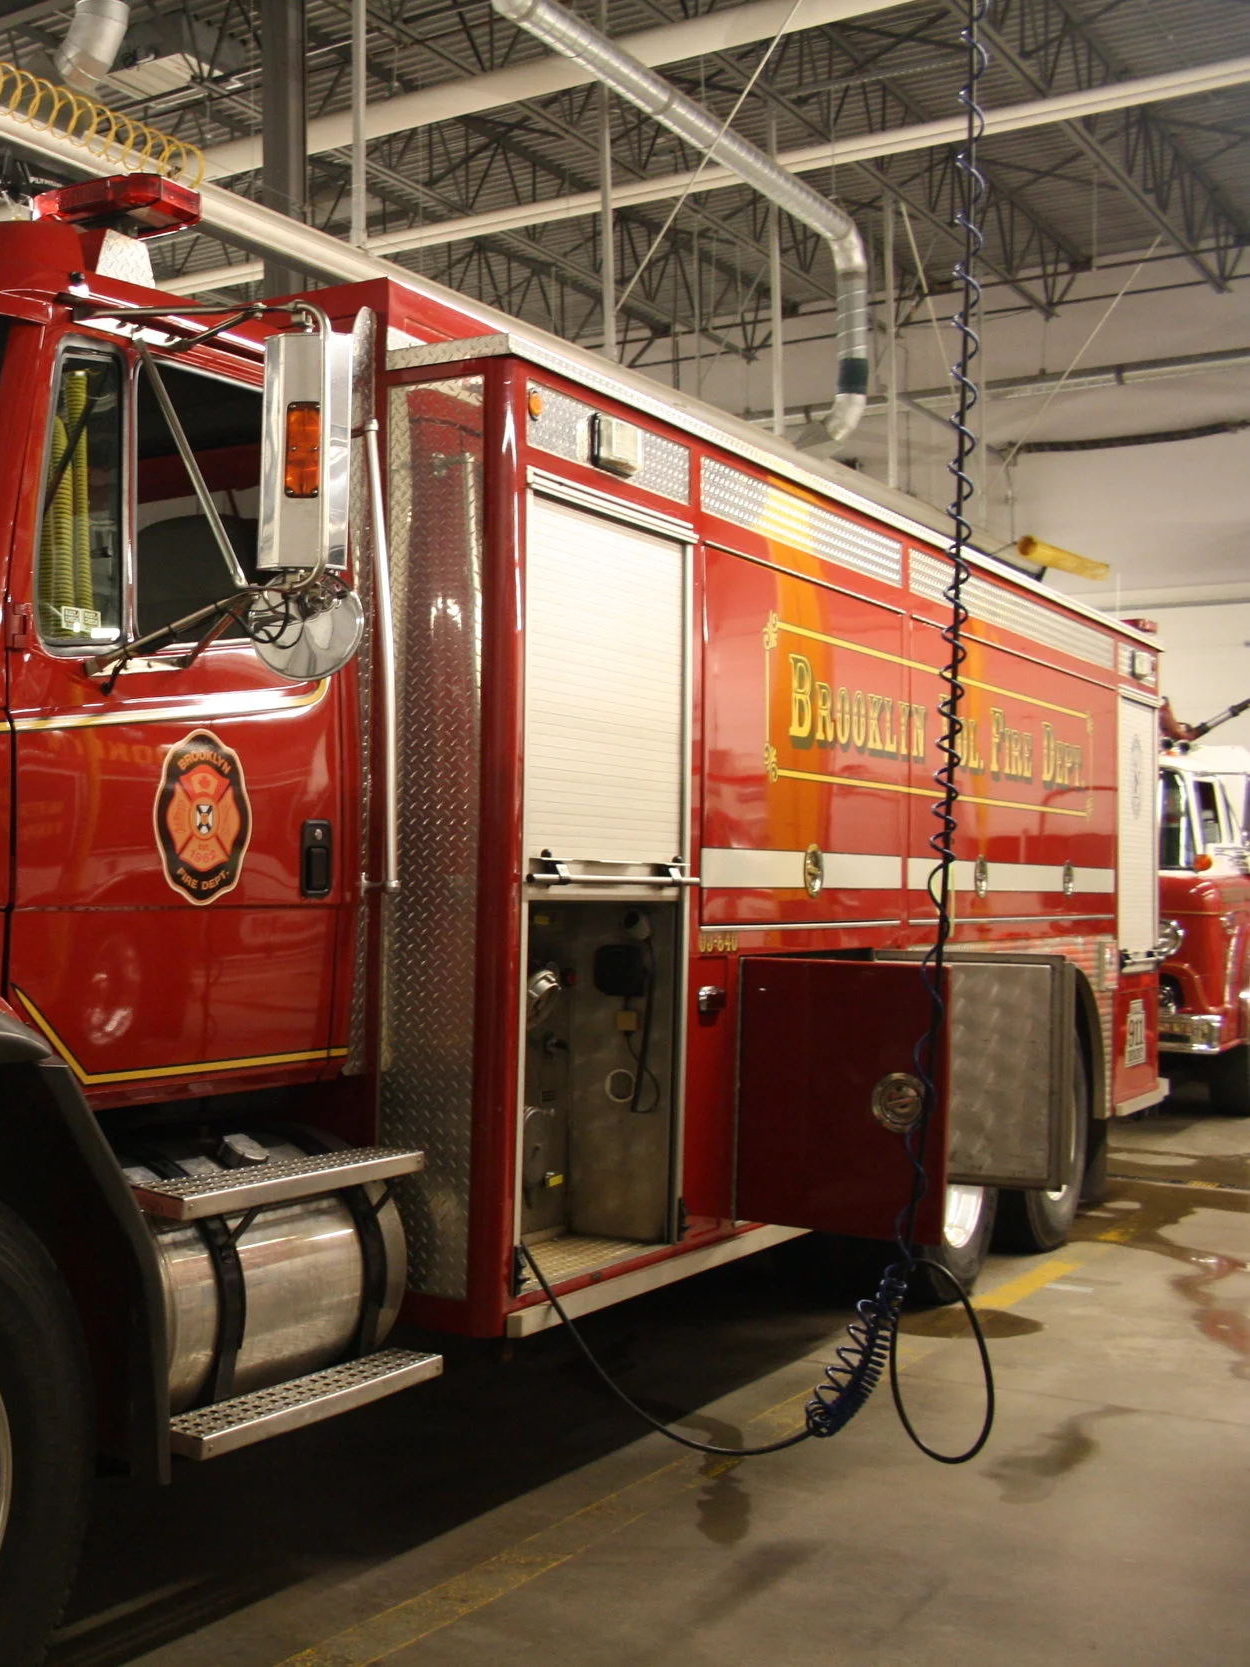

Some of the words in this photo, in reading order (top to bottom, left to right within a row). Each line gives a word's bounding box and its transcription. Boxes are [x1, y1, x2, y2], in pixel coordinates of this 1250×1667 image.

[788, 653, 926, 762] BROOKLYN
[990, 707, 1034, 779] FIRE
[177, 749, 232, 775] BROOKLYN
[176, 866, 199, 890] FIRE
[201, 869, 230, 891] DEPT.
